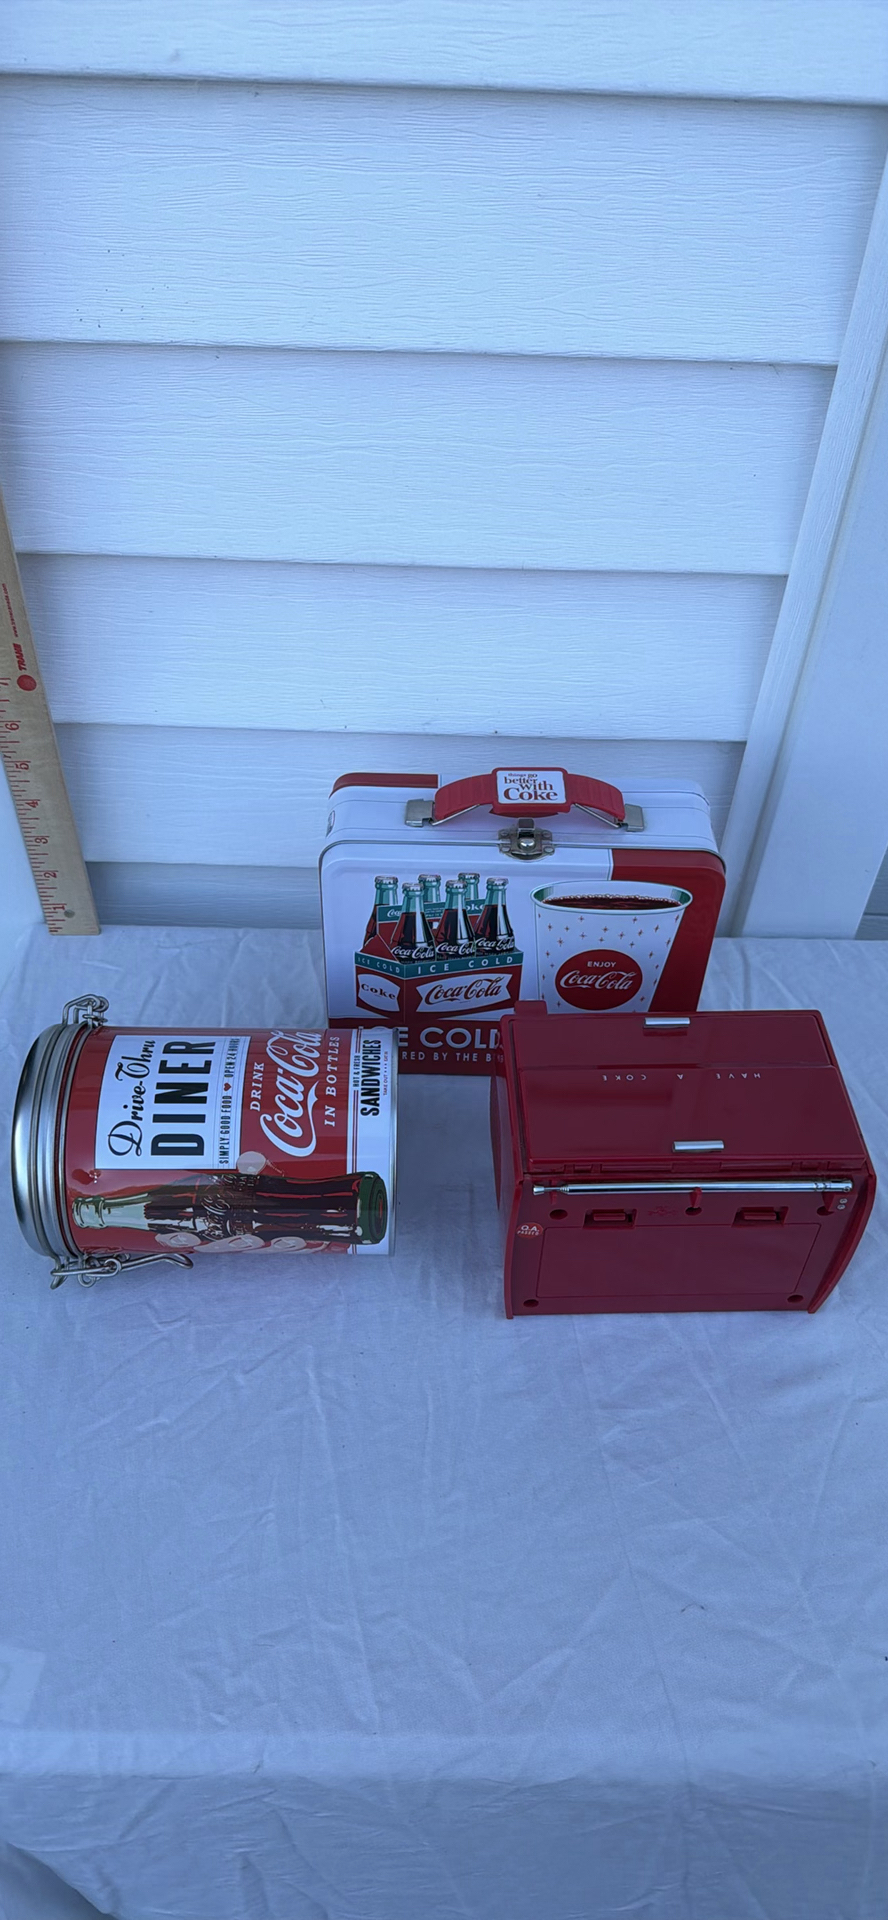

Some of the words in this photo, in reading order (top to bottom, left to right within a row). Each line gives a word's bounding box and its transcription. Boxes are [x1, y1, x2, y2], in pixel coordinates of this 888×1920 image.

[13, 643, 27, 671] TRANE
[5, 721, 20, 732] 6
[15, 762, 30, 770] 5
[503, 787, 558, 801] Coke
[519, 781, 553, 790] with
[25, 800, 39, 809] 4
[34, 836, 48, 845] 3
[44, 871, 58, 879] 2
[357, 956, 370, 966] ICE
[376, 961, 400, 974] COLD
[417, 963, 450, 975] ICE
[468, 956, 513, 968] COLD
[560, 970, 637, 990] Coca-Cola
[361, 983, 396, 1000] Coke
[425, 976, 505, 1005] Coca-Cola
[228, 1038, 240, 1052] HOURS
[353, 1055, 361, 1070] FRESH
[433, 1052, 448, 1061] BY
[456, 1052, 478, 1062] THE
[224, 1060, 236, 1078] OPEN
[326, 1036, 340, 1097] BOTTLES
[360, 1039, 382, 1117] SANDWICHES
[602, 1074, 647, 1082] COKE
[717, 1072, 761, 1080] HAVE
[250, 1062, 265, 1111] DRINK
[260, 1030, 322, 1157] Coca-Cola
[108, 1040, 156, 1157] Drive-Thru
[151, 1041, 216, 1156] DINER
[221, 1095, 232, 1113] FOOD
[220, 1115, 231, 1135] GOOD
[324, 1105, 336, 1127] IN
[219, 1139, 230, 1164] SIMPLY
